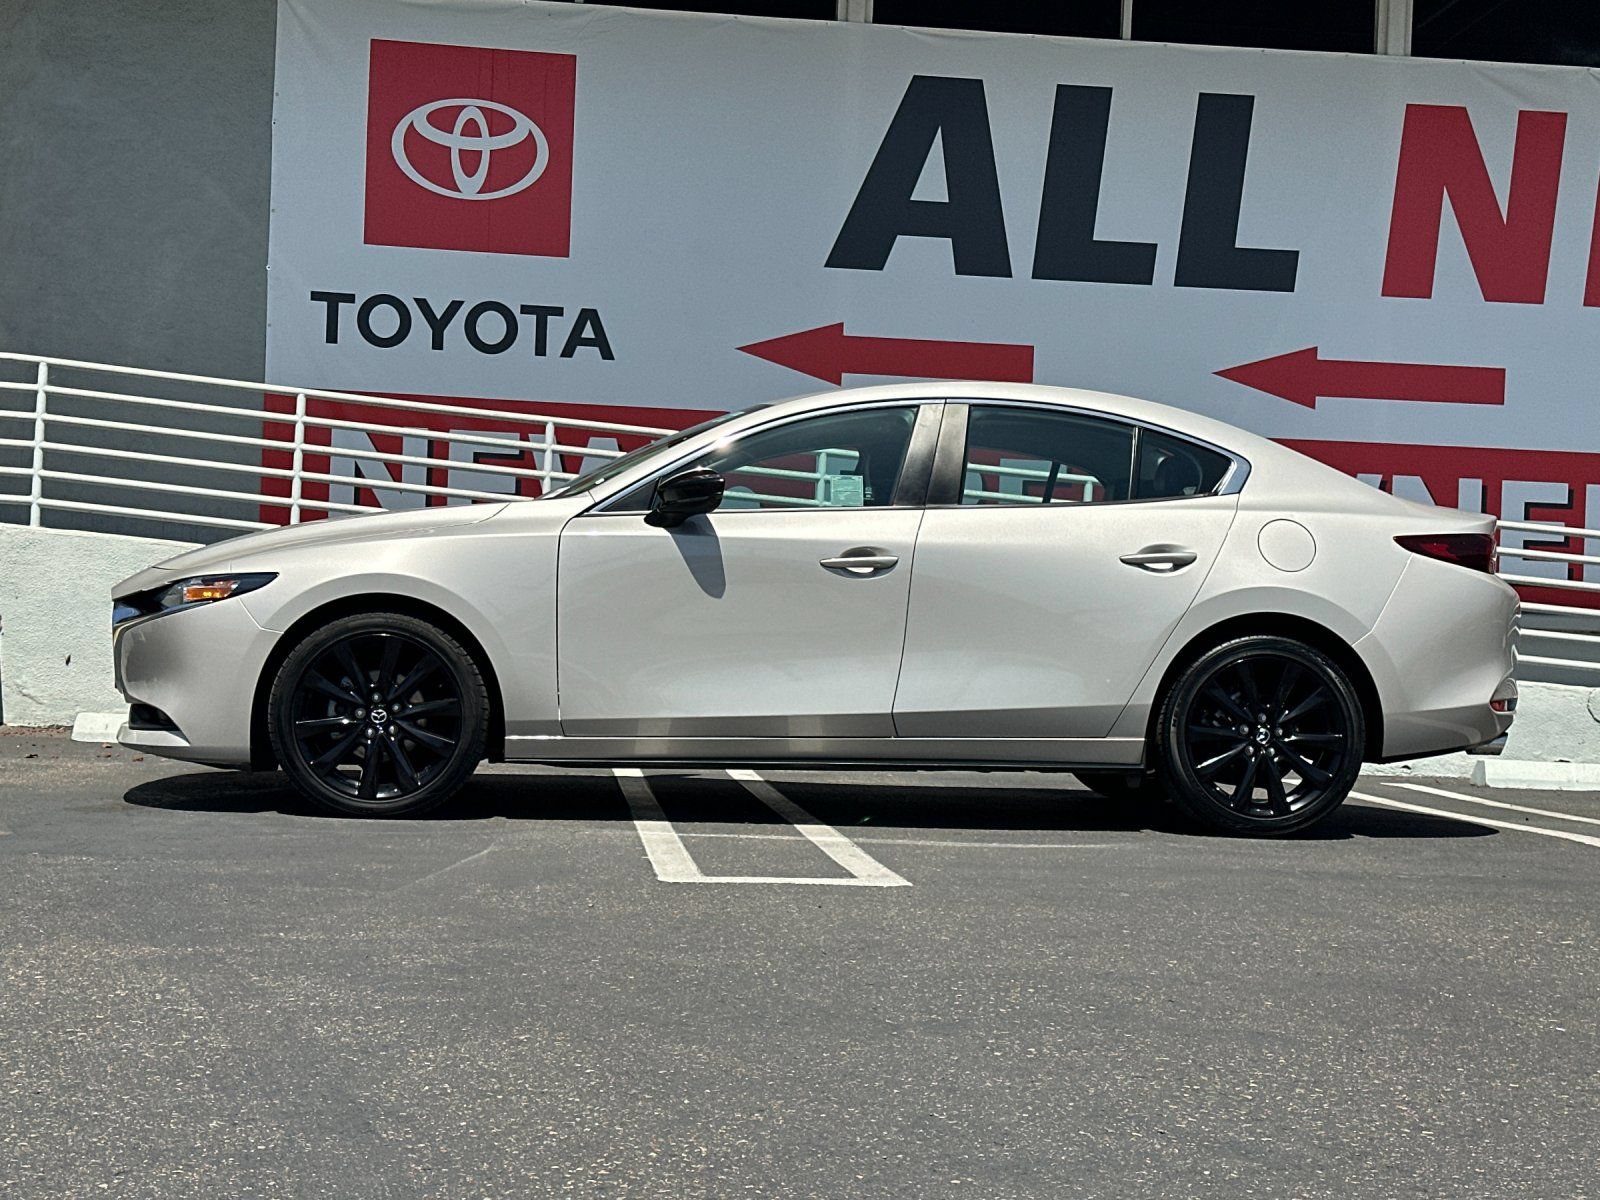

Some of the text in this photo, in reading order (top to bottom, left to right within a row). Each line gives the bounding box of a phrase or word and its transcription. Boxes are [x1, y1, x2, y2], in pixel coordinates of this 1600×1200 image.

[824, 75, 1600, 307] ALL N
[310, 291, 615, 361] TOYOTA
